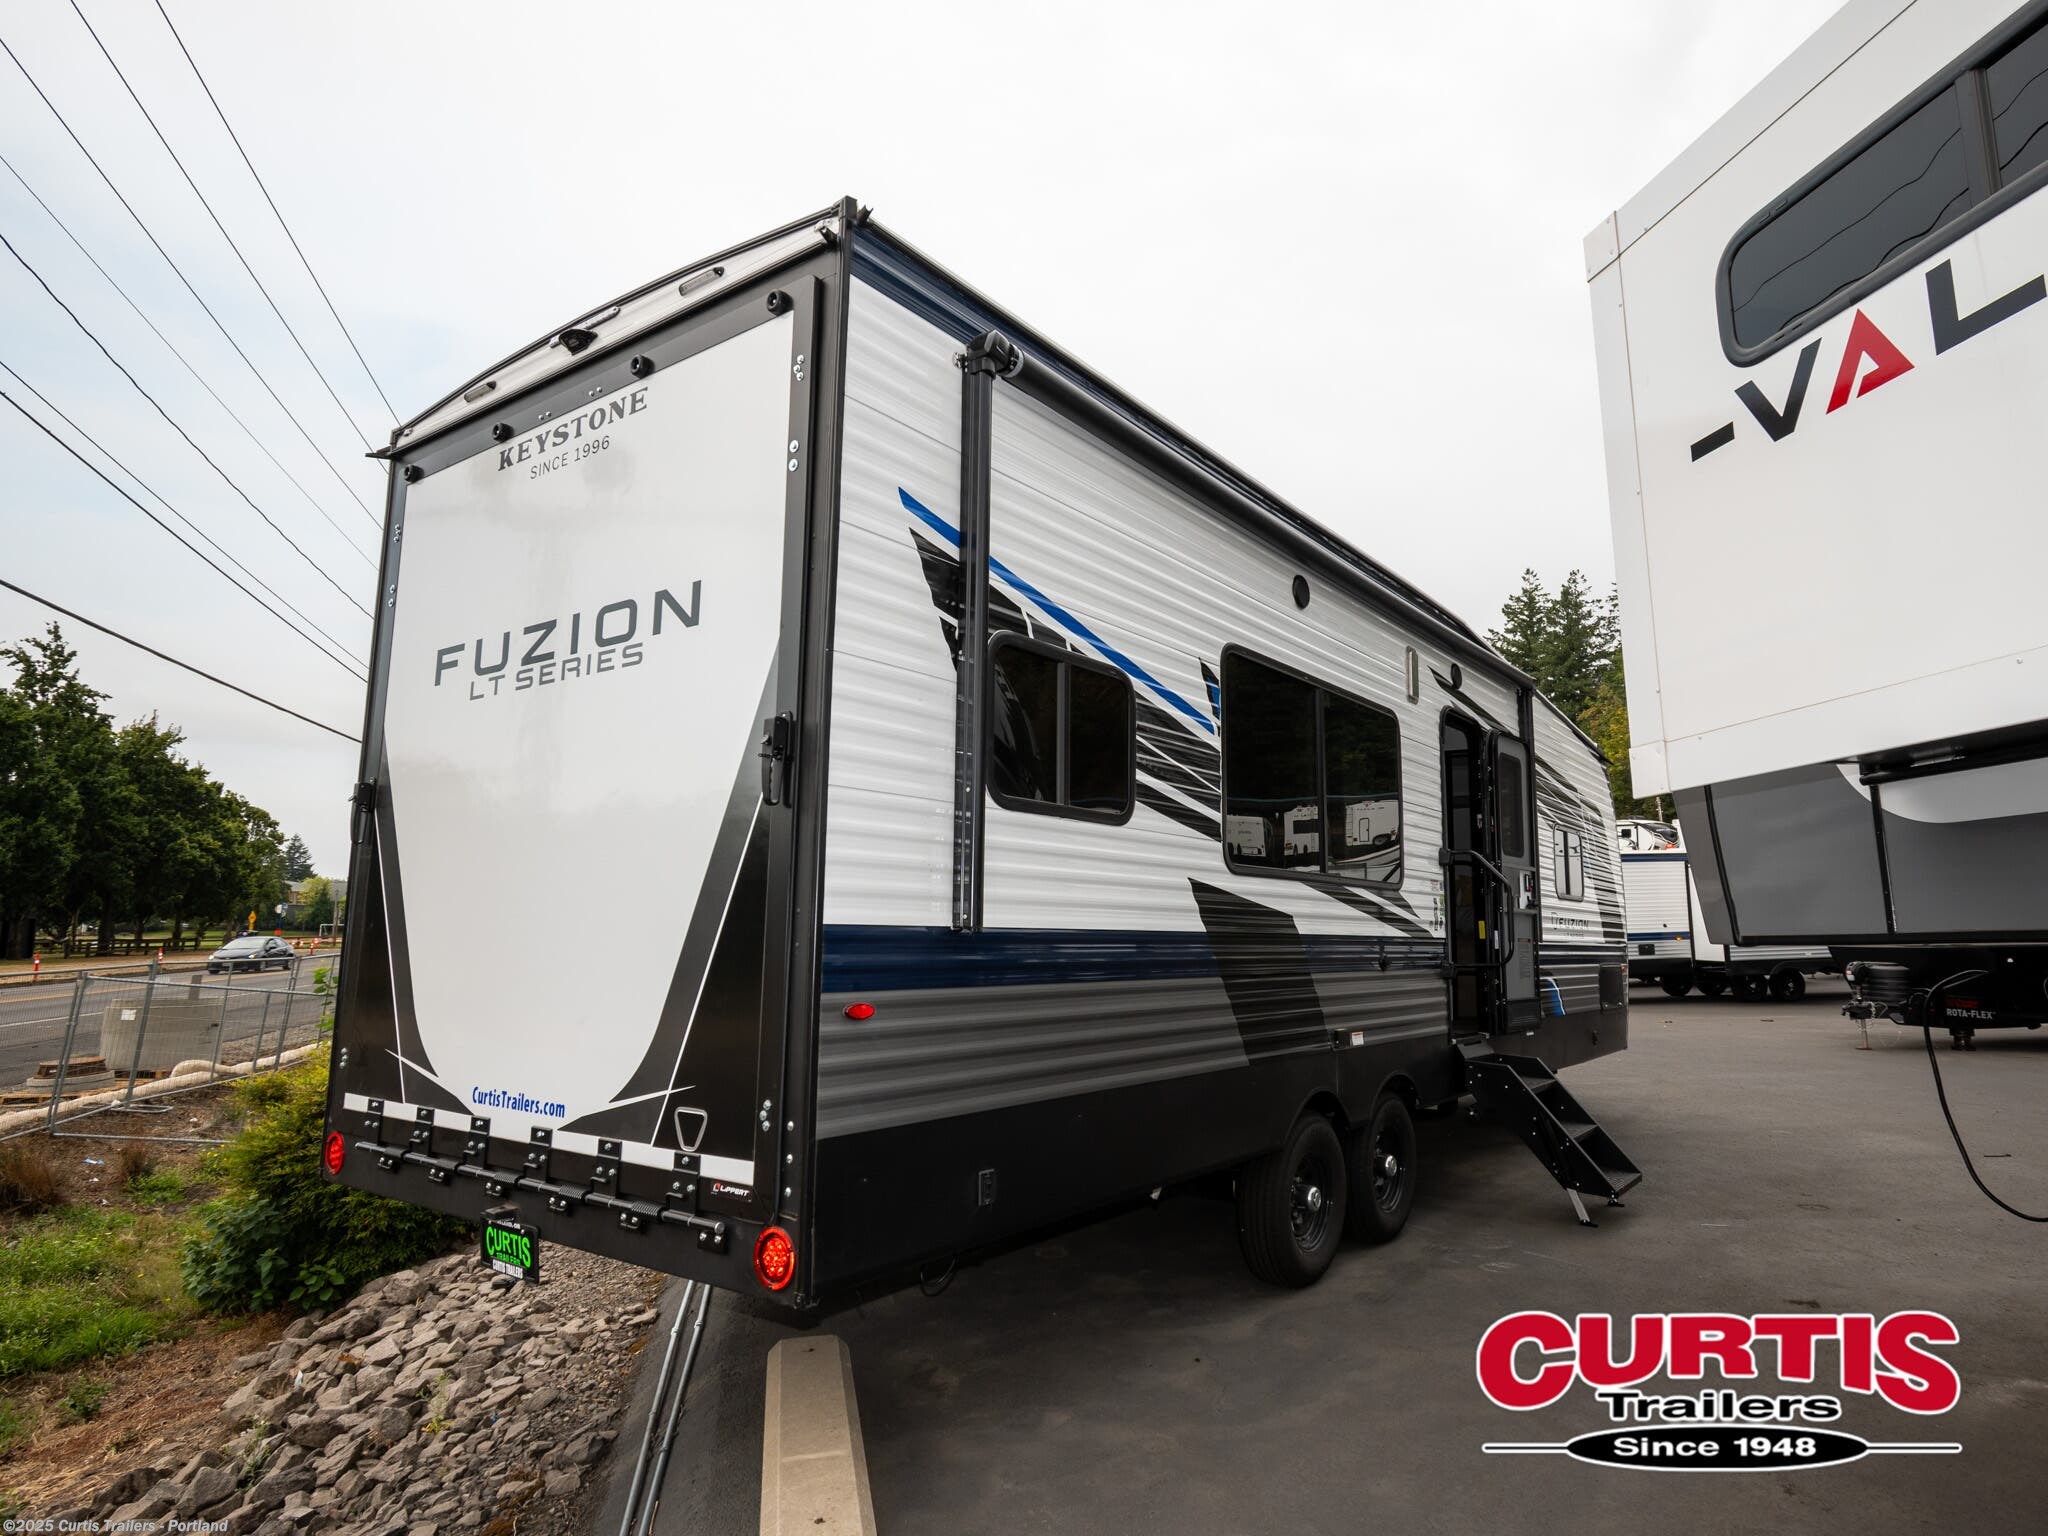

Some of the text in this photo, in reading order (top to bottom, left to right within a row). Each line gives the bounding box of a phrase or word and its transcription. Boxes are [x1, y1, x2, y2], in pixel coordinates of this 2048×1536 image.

[498, 387, 648, 471] KEYSTONE
[530, 435, 610, 480] SINCE 1996
[434, 580, 702, 686] FUZION
[469, 643, 644, 701] LT SERIES
[1946, 1008, 1993, 1020] ROTA-FLEX
[472, 1086, 565, 1118] CurtisTrailers.com
[486, 1226, 531, 1268] CURTIS
